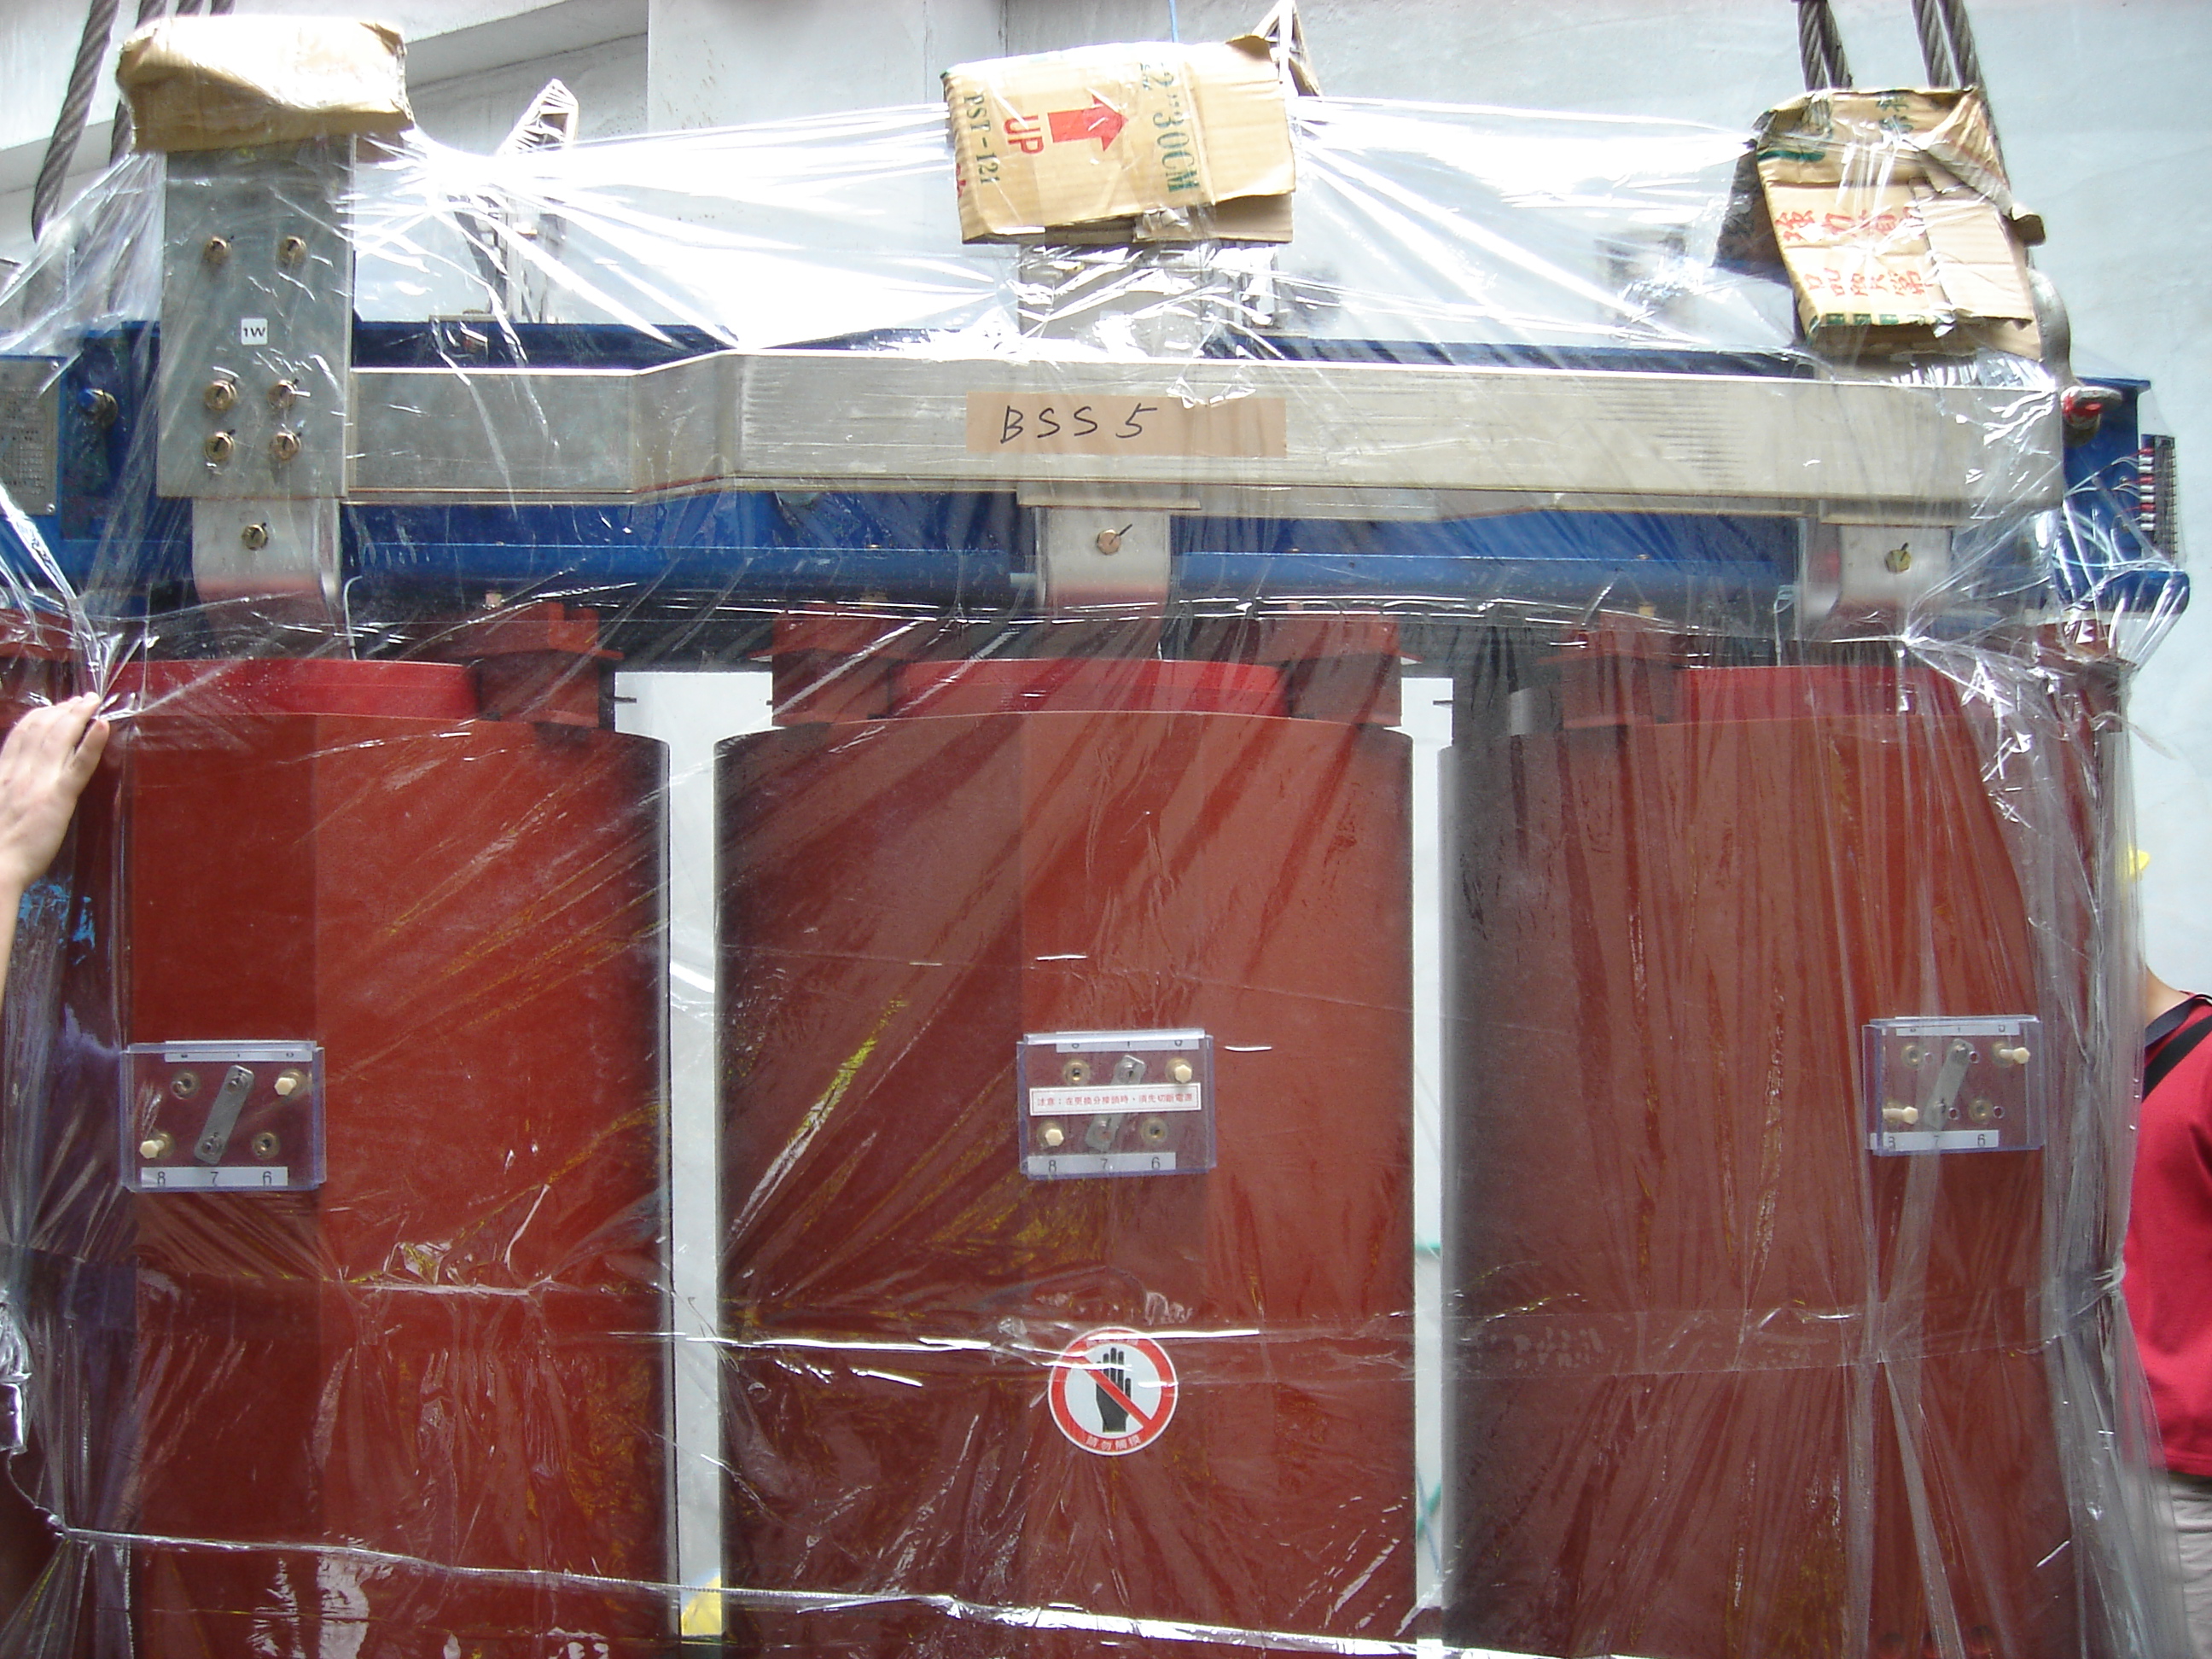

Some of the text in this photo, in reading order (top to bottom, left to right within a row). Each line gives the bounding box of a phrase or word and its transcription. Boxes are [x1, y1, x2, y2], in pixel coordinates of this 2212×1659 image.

[1003, 114, 1045, 154] UP
[243, 327, 265, 337] 1W
[1151, 1157, 1161, 1170] 6
[210, 1172, 219, 1186] 7
